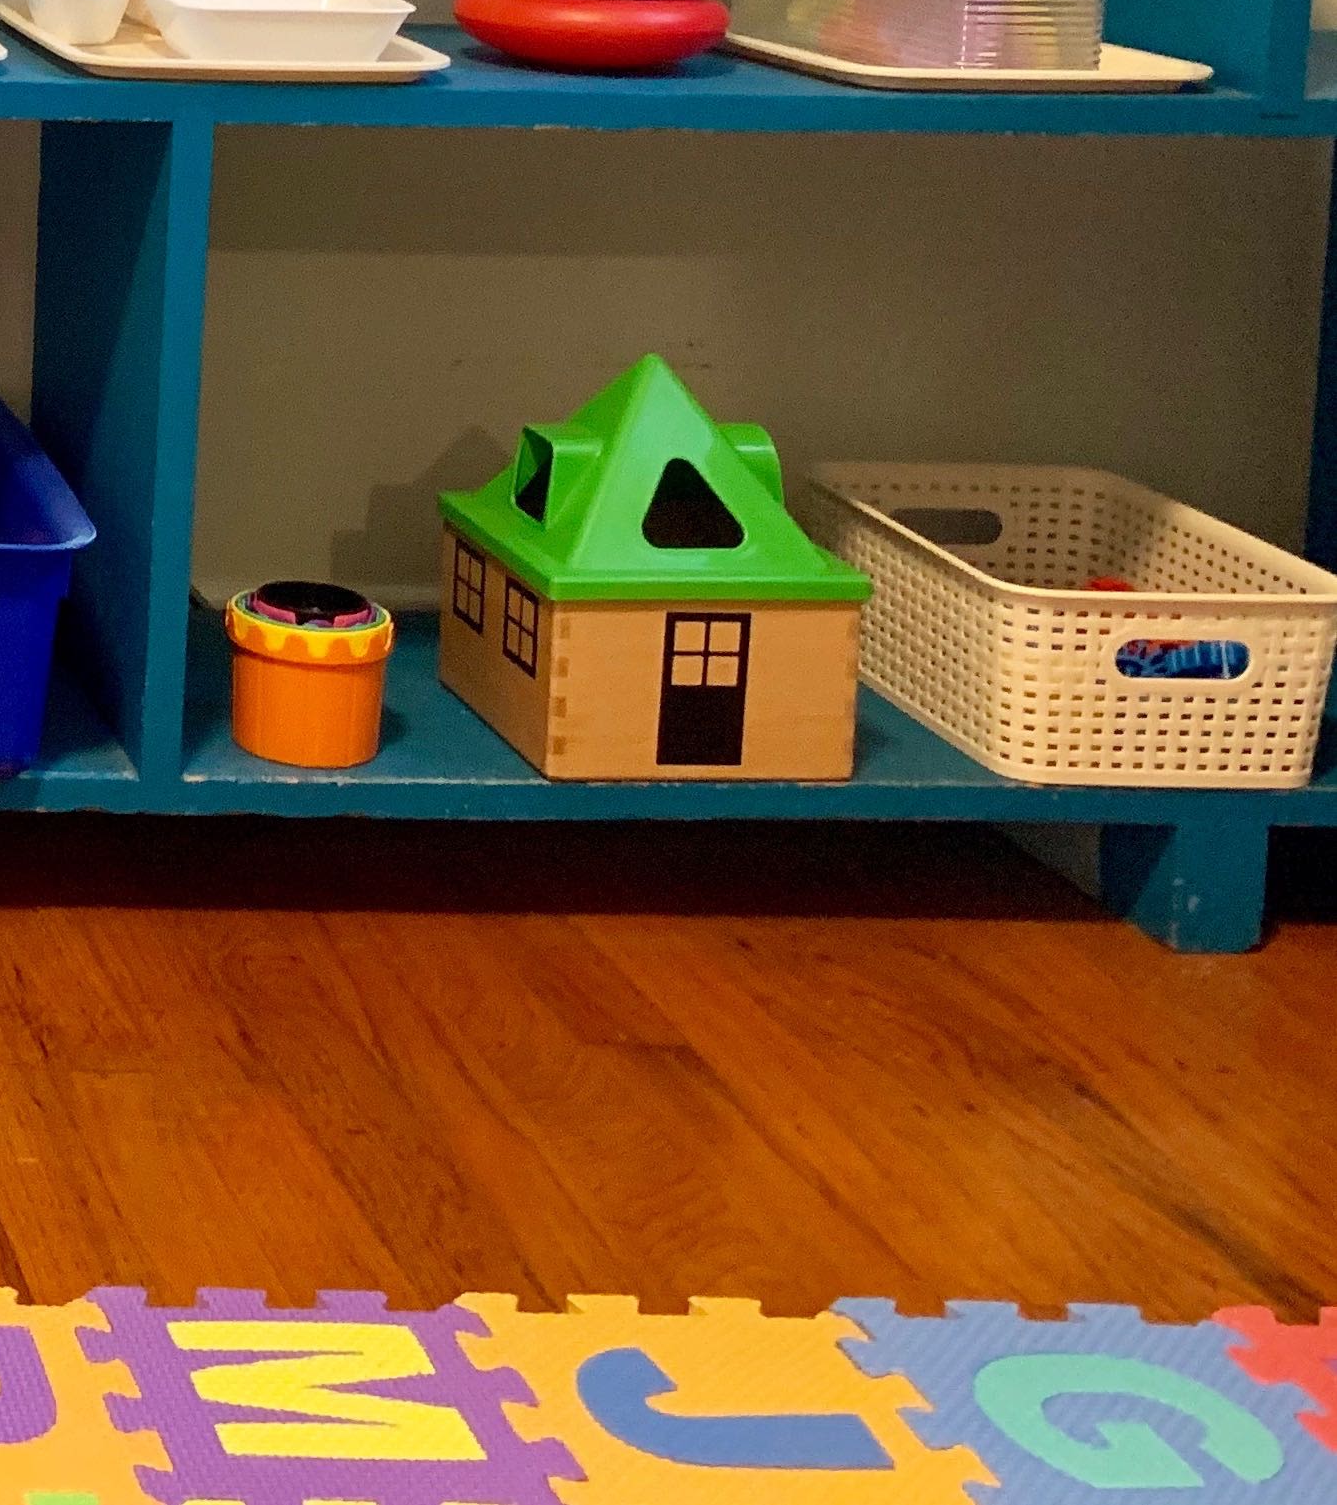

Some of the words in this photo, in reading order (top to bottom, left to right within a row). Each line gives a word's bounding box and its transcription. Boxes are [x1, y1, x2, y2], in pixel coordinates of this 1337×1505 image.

[166, 1321, 488, 1462] M
[577, 1347, 895, 1470] J
[973, 1353, 1285, 1489] G
